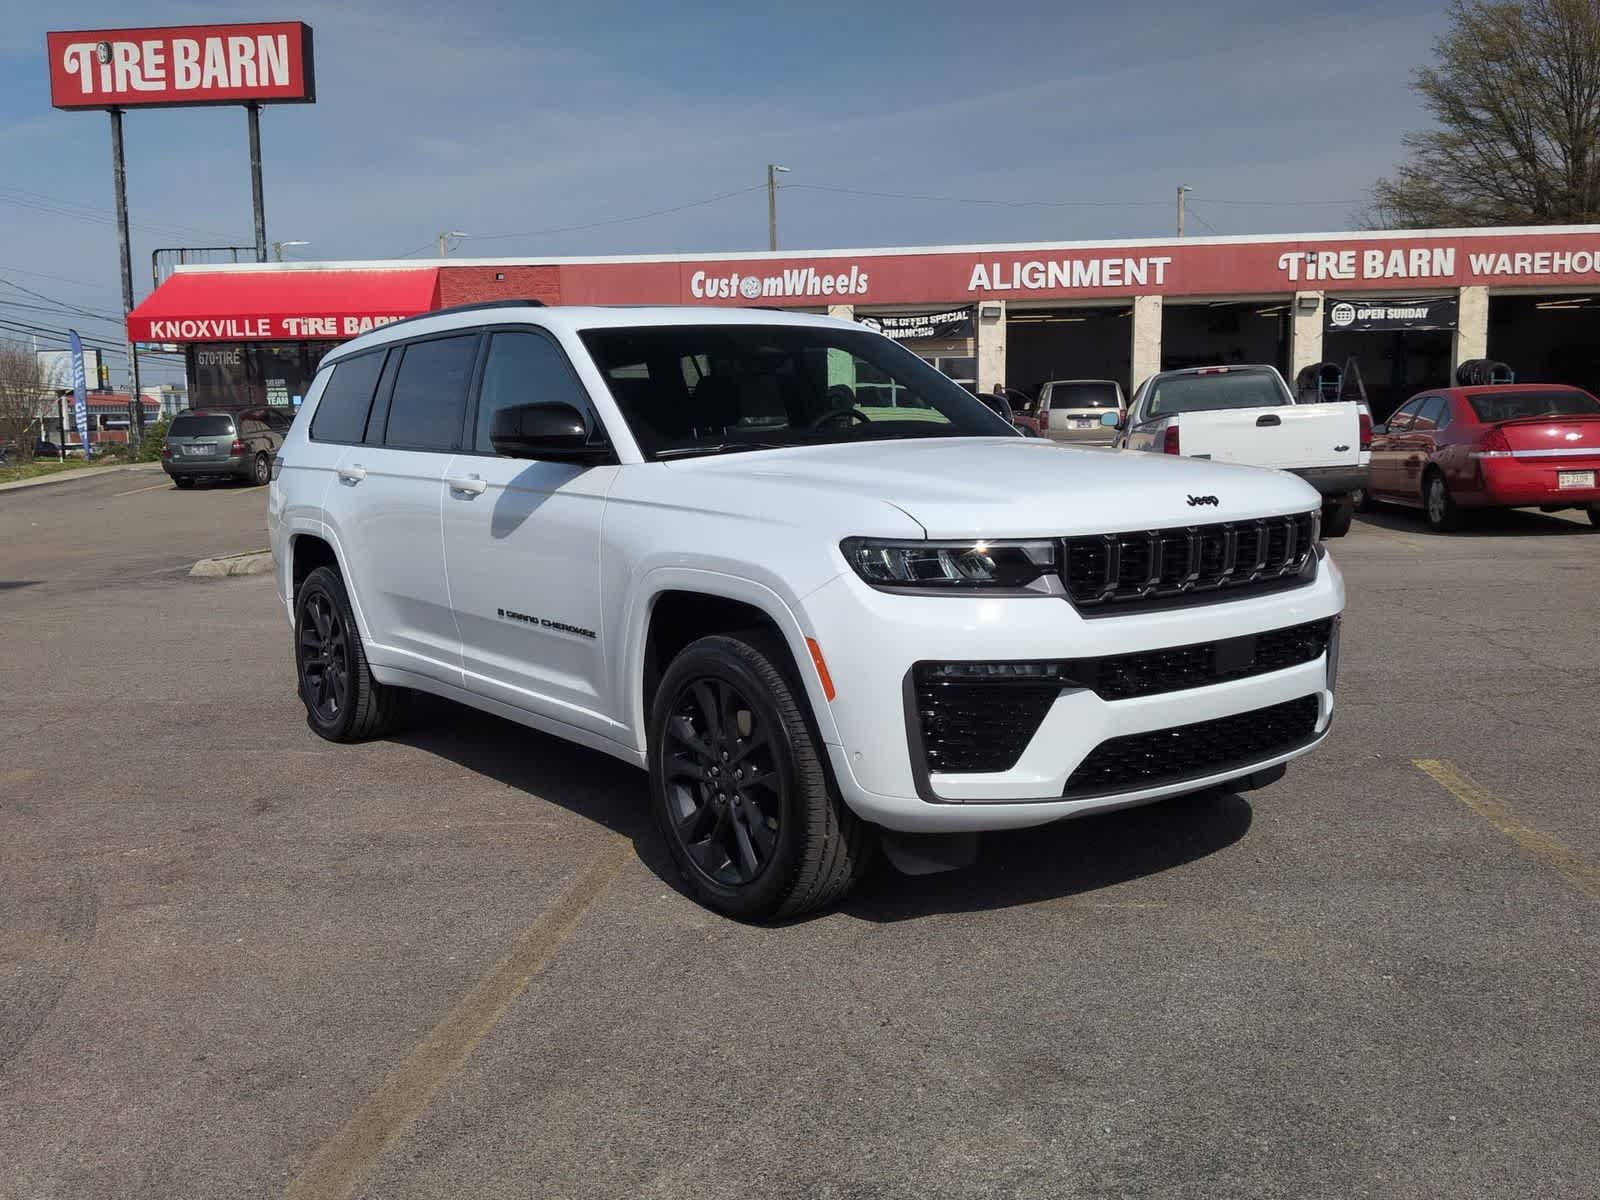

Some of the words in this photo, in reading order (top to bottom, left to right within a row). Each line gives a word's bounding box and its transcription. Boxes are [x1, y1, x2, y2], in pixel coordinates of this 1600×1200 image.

[173, 35, 289, 89] BARN
[1363, 247, 1455, 279] BARN
[968, 256, 1172, 291] ALIGNMENT
[882, 317, 898, 328] WE
[899, 316, 929, 327] OFFER
[930, 310, 969, 325] SPECIAL
[1357, 308, 1385, 320] OPEN
[1386, 307, 1429, 319] SUNDAY
[150, 318, 272, 339] KNOXVILLE
[881, 326, 935, 339] FINANCING
[267, 397, 289, 405] TEAM
[1186, 494, 1219, 508] Jeep
[506, 610, 540, 624] GRAND
[541, 619, 597, 637] CHEROKEE
